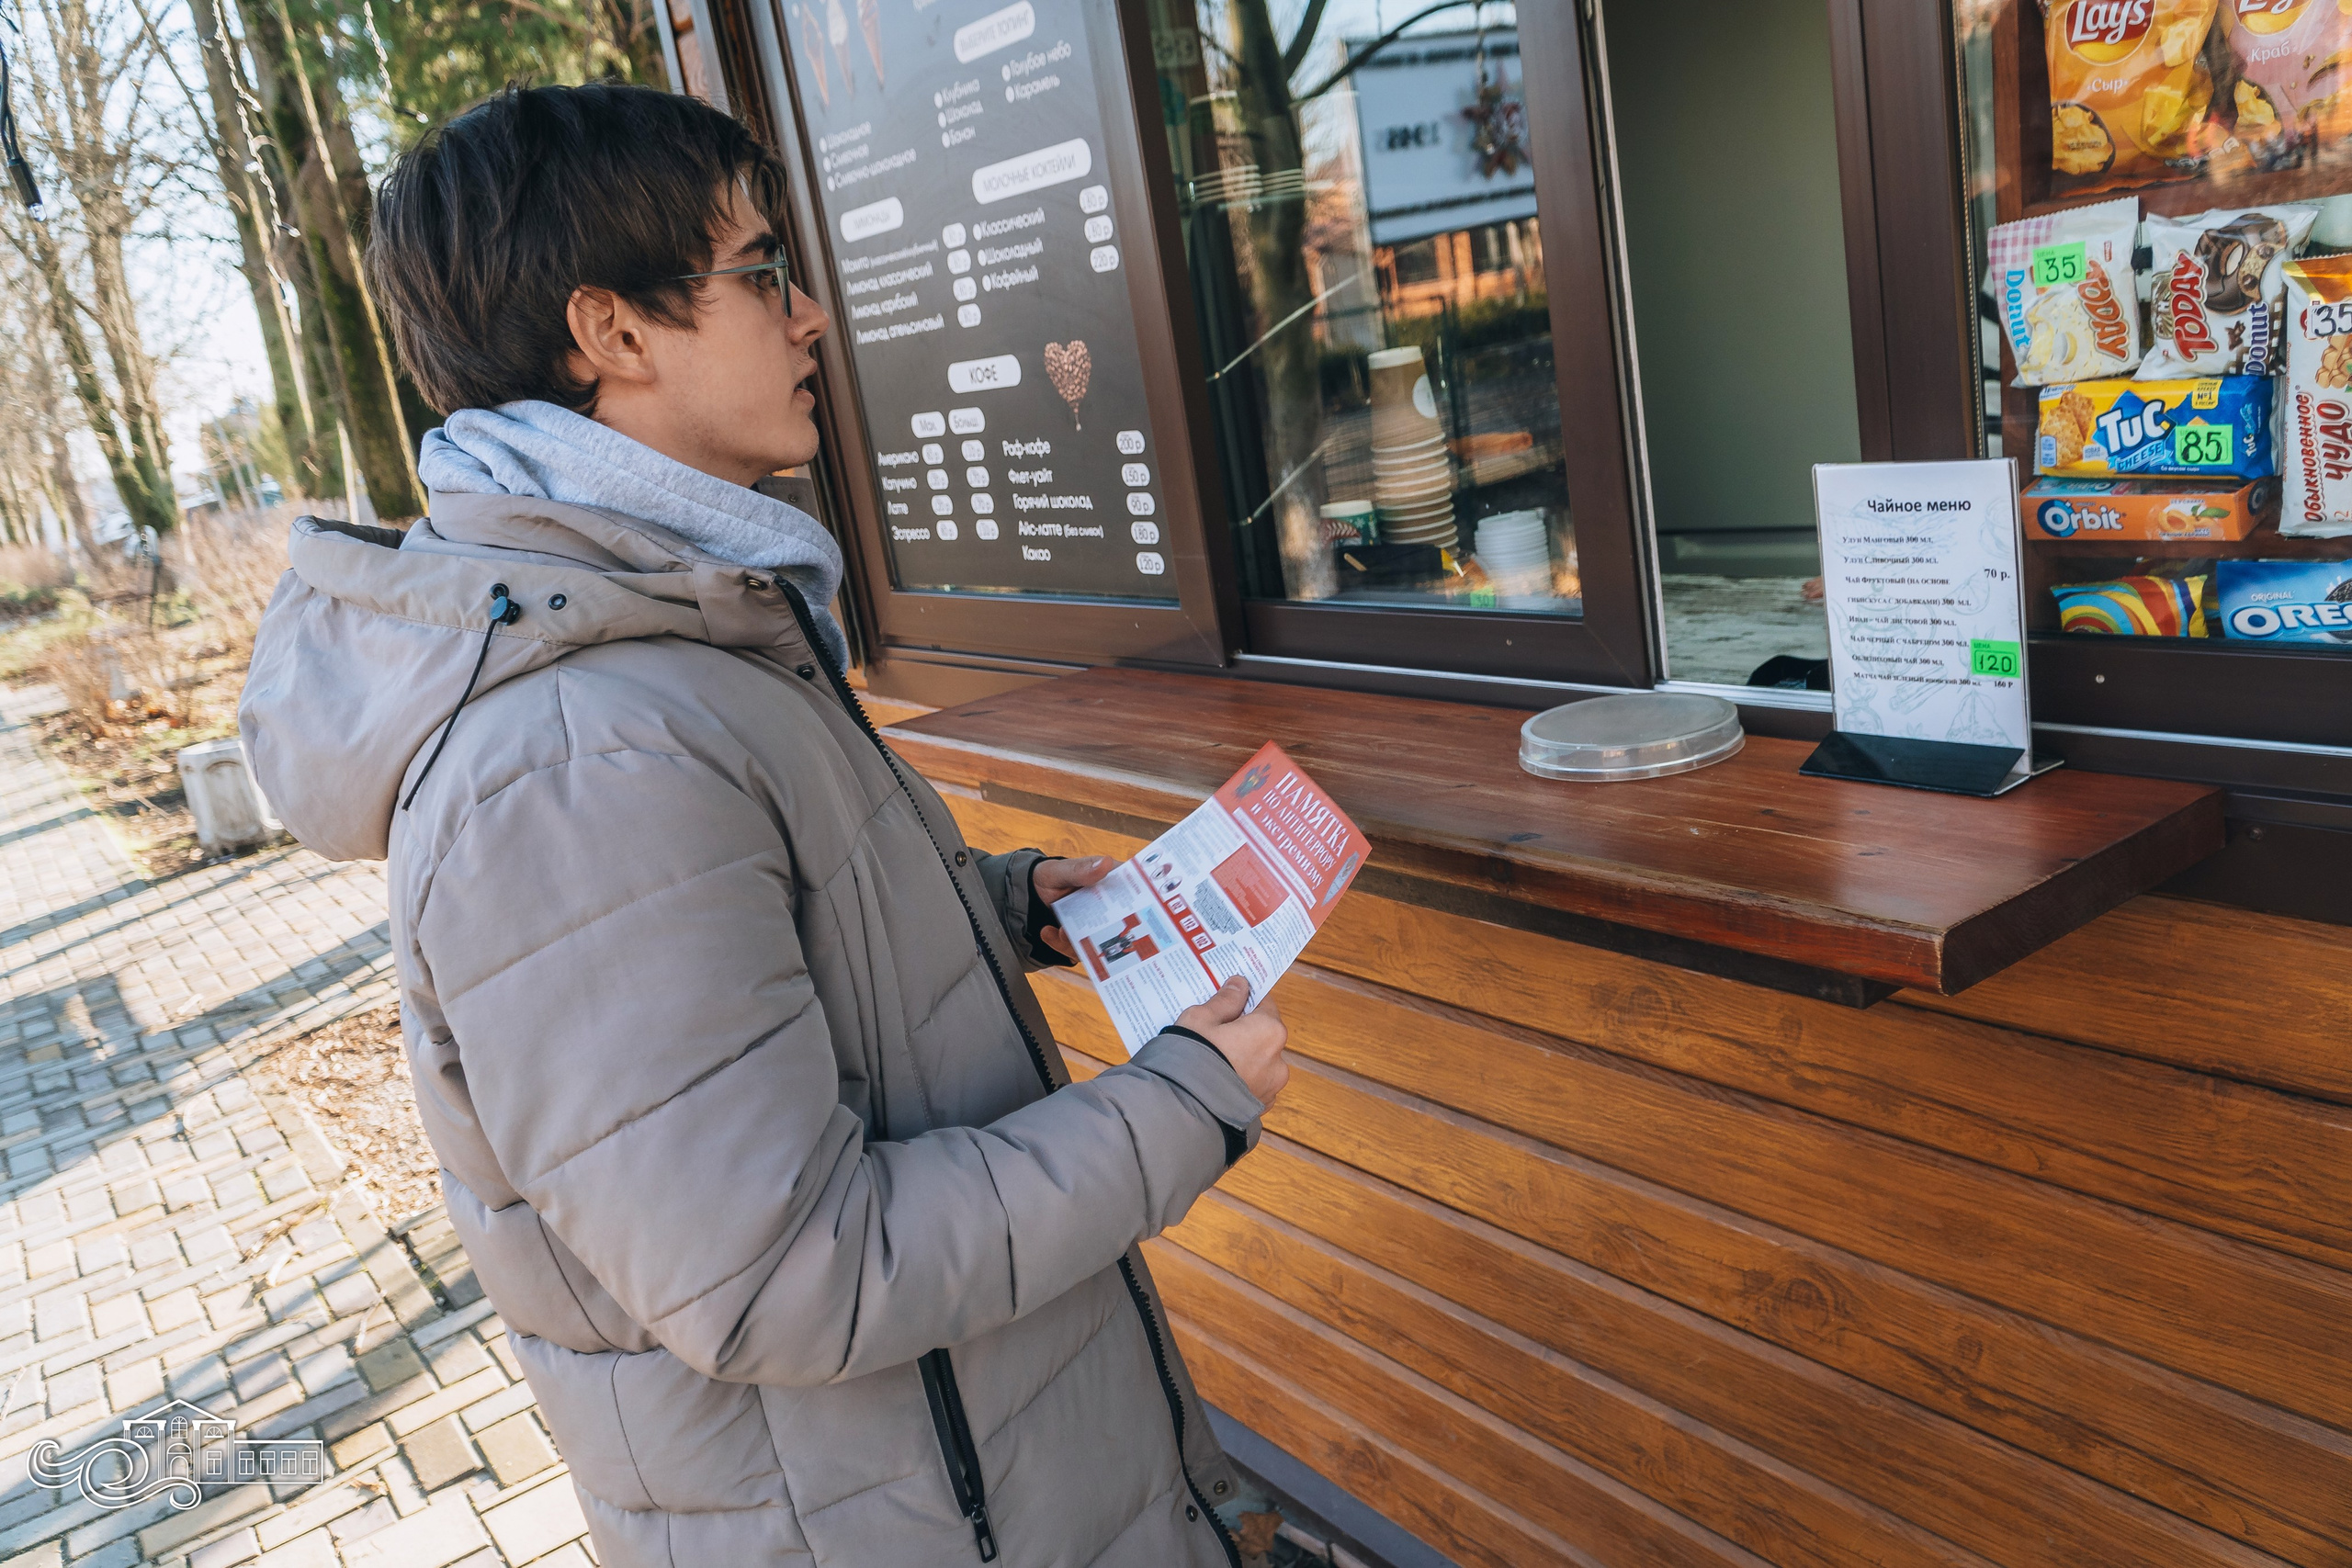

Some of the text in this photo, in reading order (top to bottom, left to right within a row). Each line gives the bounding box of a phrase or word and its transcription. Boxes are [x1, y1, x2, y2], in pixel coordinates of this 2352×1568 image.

[2044, 254, 2075, 282] 35
[2007, 270, 2030, 348] Donut
[2078, 260, 2127, 359] TODAY
[2170, 254, 2217, 359] TODAY
[2245, 302, 2268, 375] Donut
[968, 365, 999, 384] КОФЕ
[1001, 436, 1051, 459] Раф-кофе
[2117, 441, 2163, 472] CHEESE
[2181, 431, 2222, 464] 85
[877, 451, 920, 468] Американо
[881, 476, 918, 493] Капучино
[1012, 492, 1050, 513] Горячий
[1050, 495, 1093, 511] шоколад
[1867, 498, 1972, 513] Чайное меню
[2044, 502, 2124, 532] Orbit
[1018, 520, 1063, 536] Айс-латте
[1905, 536, 1919, 544] 300
[1022, 544, 1052, 561] Какао
[1984, 569, 1997, 579] 70
[2250, 592, 2294, 603] ORIGINAL
[1980, 654, 2012, 672] 120
[1274, 771, 1351, 858] ПАМЯТКА
[1262, 789, 1282, 809] ПО
[1275, 807, 1337, 872] АНТИТЕРРОРУ
[1261, 812, 1324, 890] экстремизму
[1183, 918, 1196, 930] 112
[1195, 935, 1209, 947] 102
